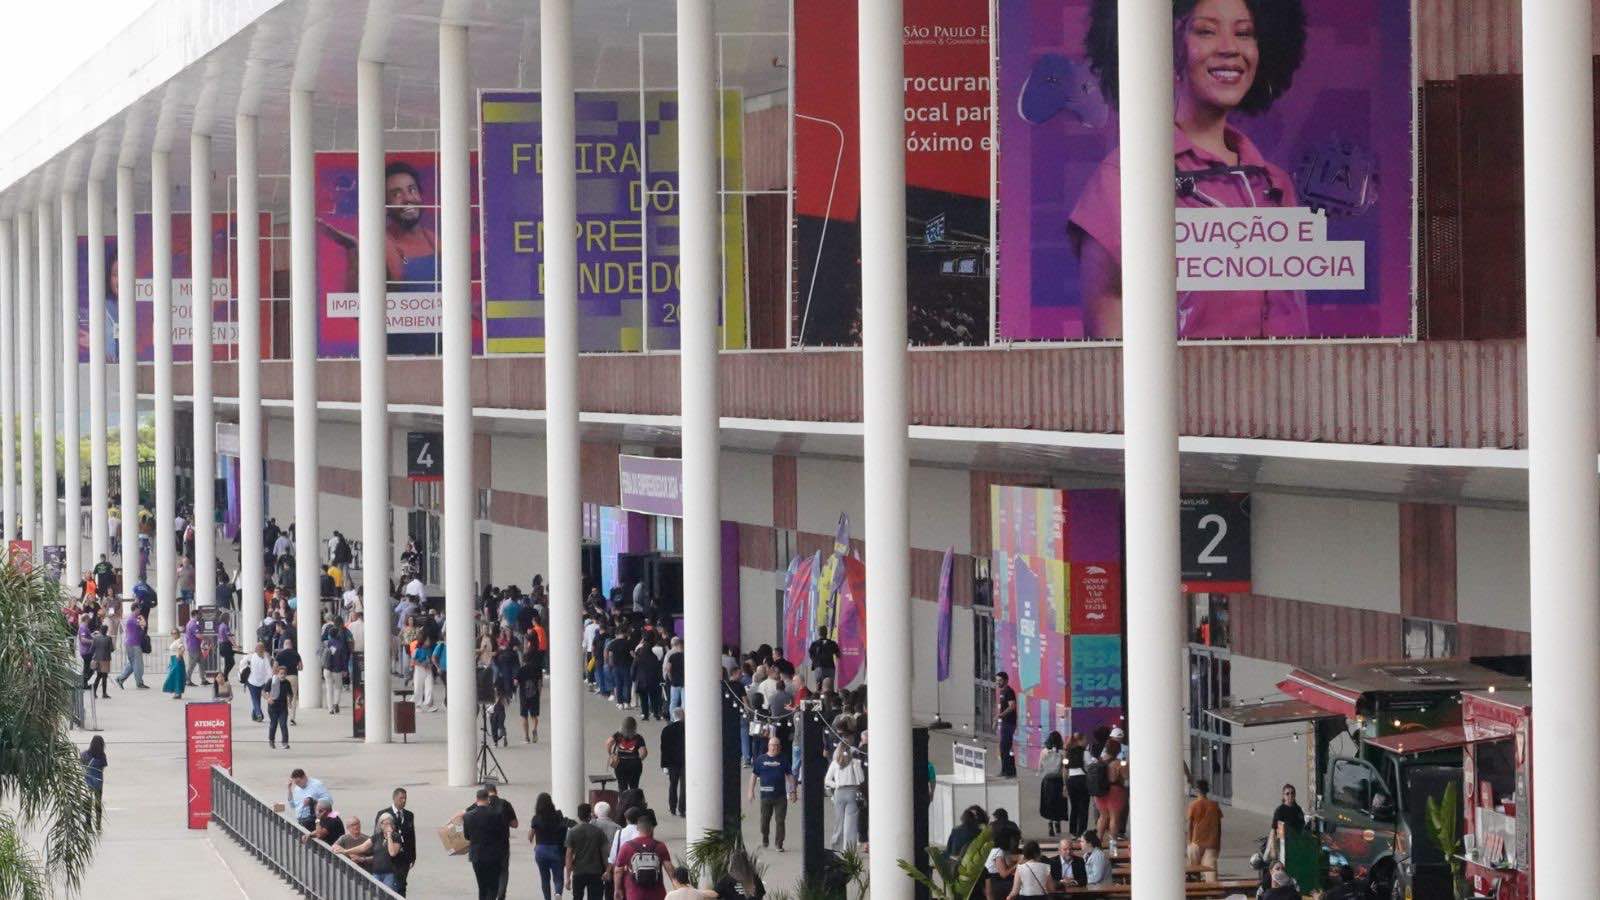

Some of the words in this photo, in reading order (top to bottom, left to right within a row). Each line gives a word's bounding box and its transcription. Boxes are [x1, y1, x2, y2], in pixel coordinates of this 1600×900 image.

[904, 25, 930, 37] SÃO
[935, 25, 976, 36] PAULO
[629, 180, 674, 212] DO
[1298, 221, 1314, 242] E
[1176, 256, 1355, 278] TECNOLOGIA
[416, 442, 434, 468] 4
[1197, 513, 1229, 564] 2
[1072, 672, 1121, 690] FE24
[194, 719, 226, 729] ATENÇÃO
